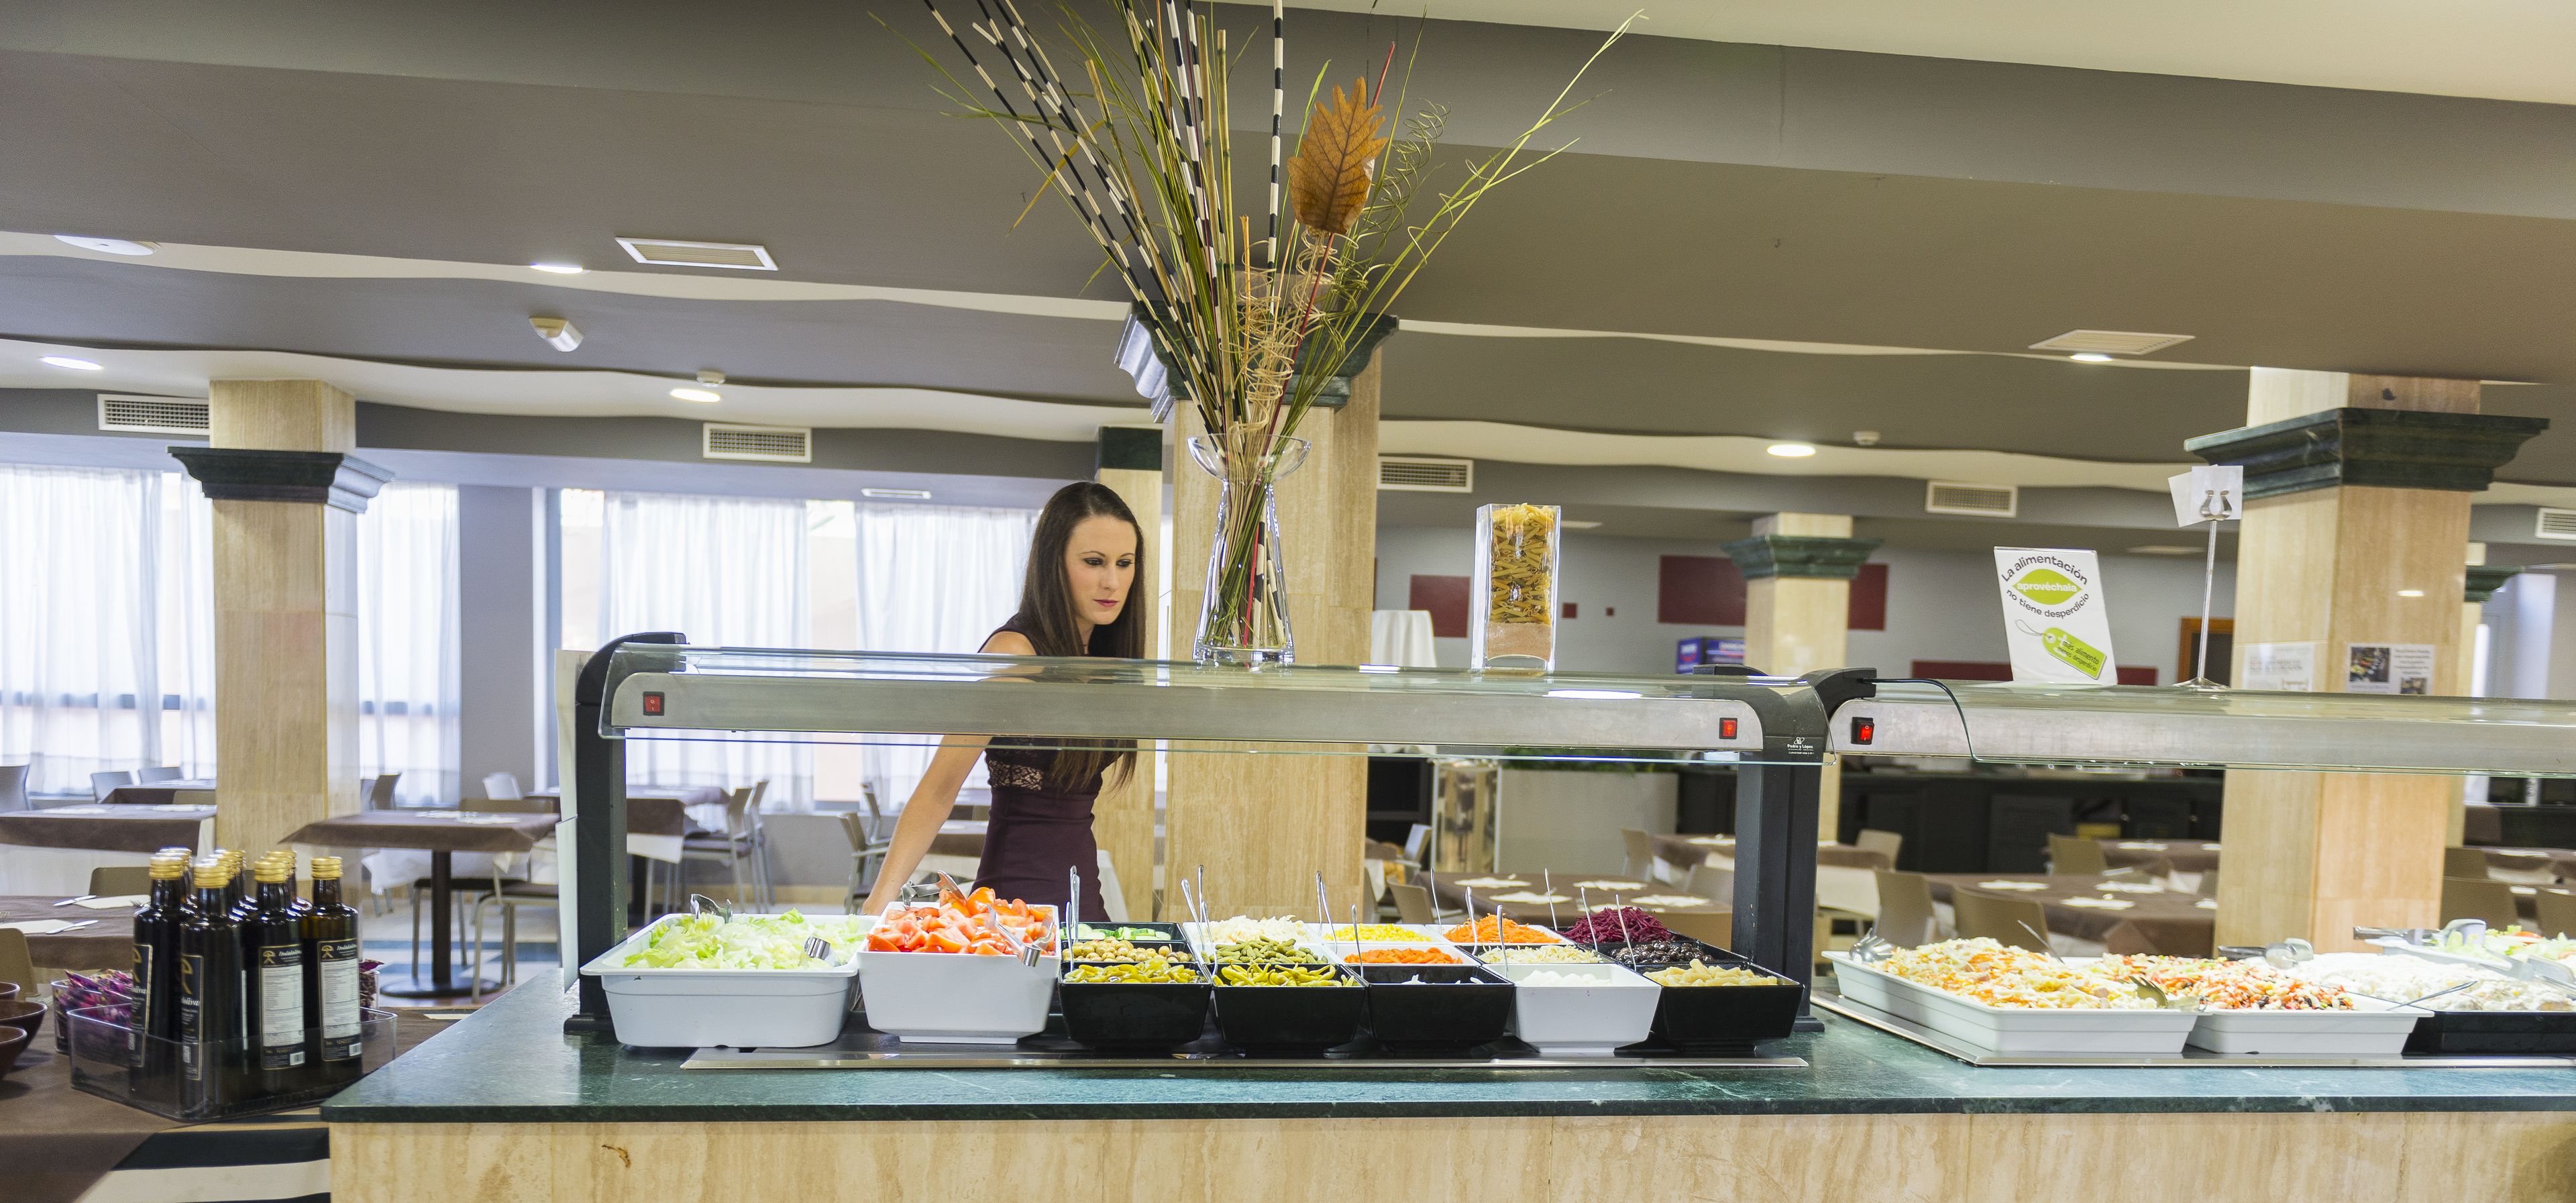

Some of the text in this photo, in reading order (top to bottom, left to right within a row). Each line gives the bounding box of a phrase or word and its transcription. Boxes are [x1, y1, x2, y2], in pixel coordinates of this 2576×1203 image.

[2001, 556, 2088, 585] La alimentación
[2017, 582, 2077, 592] aprovéchala
[2006, 589, 2089, 619] no tiene desperdicio
[2057, 646, 2097, 672] menos desperdicio
[2062, 639, 2100, 665] más alimento
